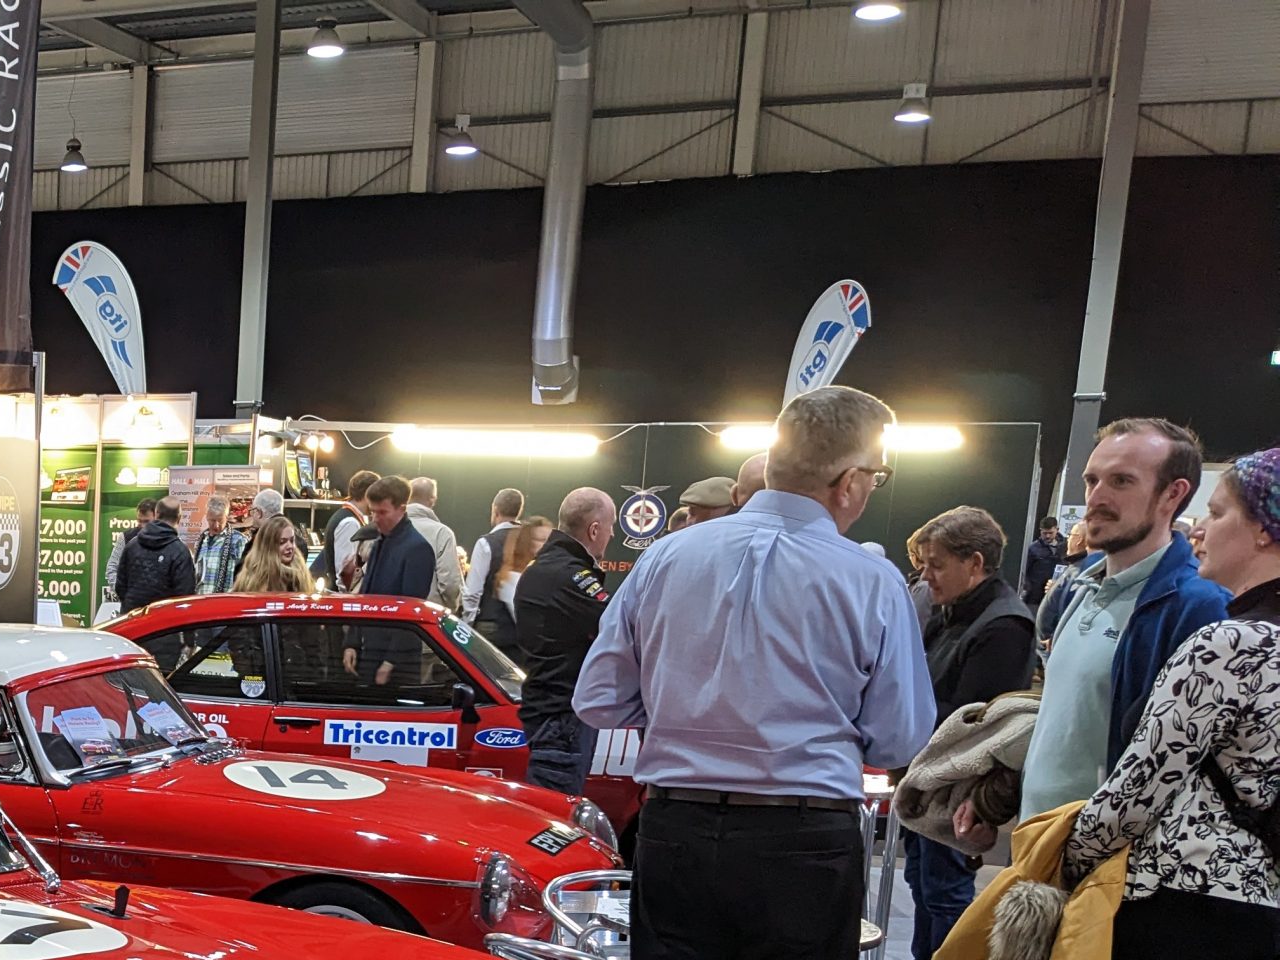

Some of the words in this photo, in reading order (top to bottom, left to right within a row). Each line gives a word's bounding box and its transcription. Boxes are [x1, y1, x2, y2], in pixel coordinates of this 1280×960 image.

[799, 349, 828, 387] itg
[39, 518, 86, 537] 7,000
[209, 713, 230, 724] OIL
[329, 722, 454, 747] Tricentrol
[485, 730, 520, 744] Ford
[254, 765, 349, 790] 14
